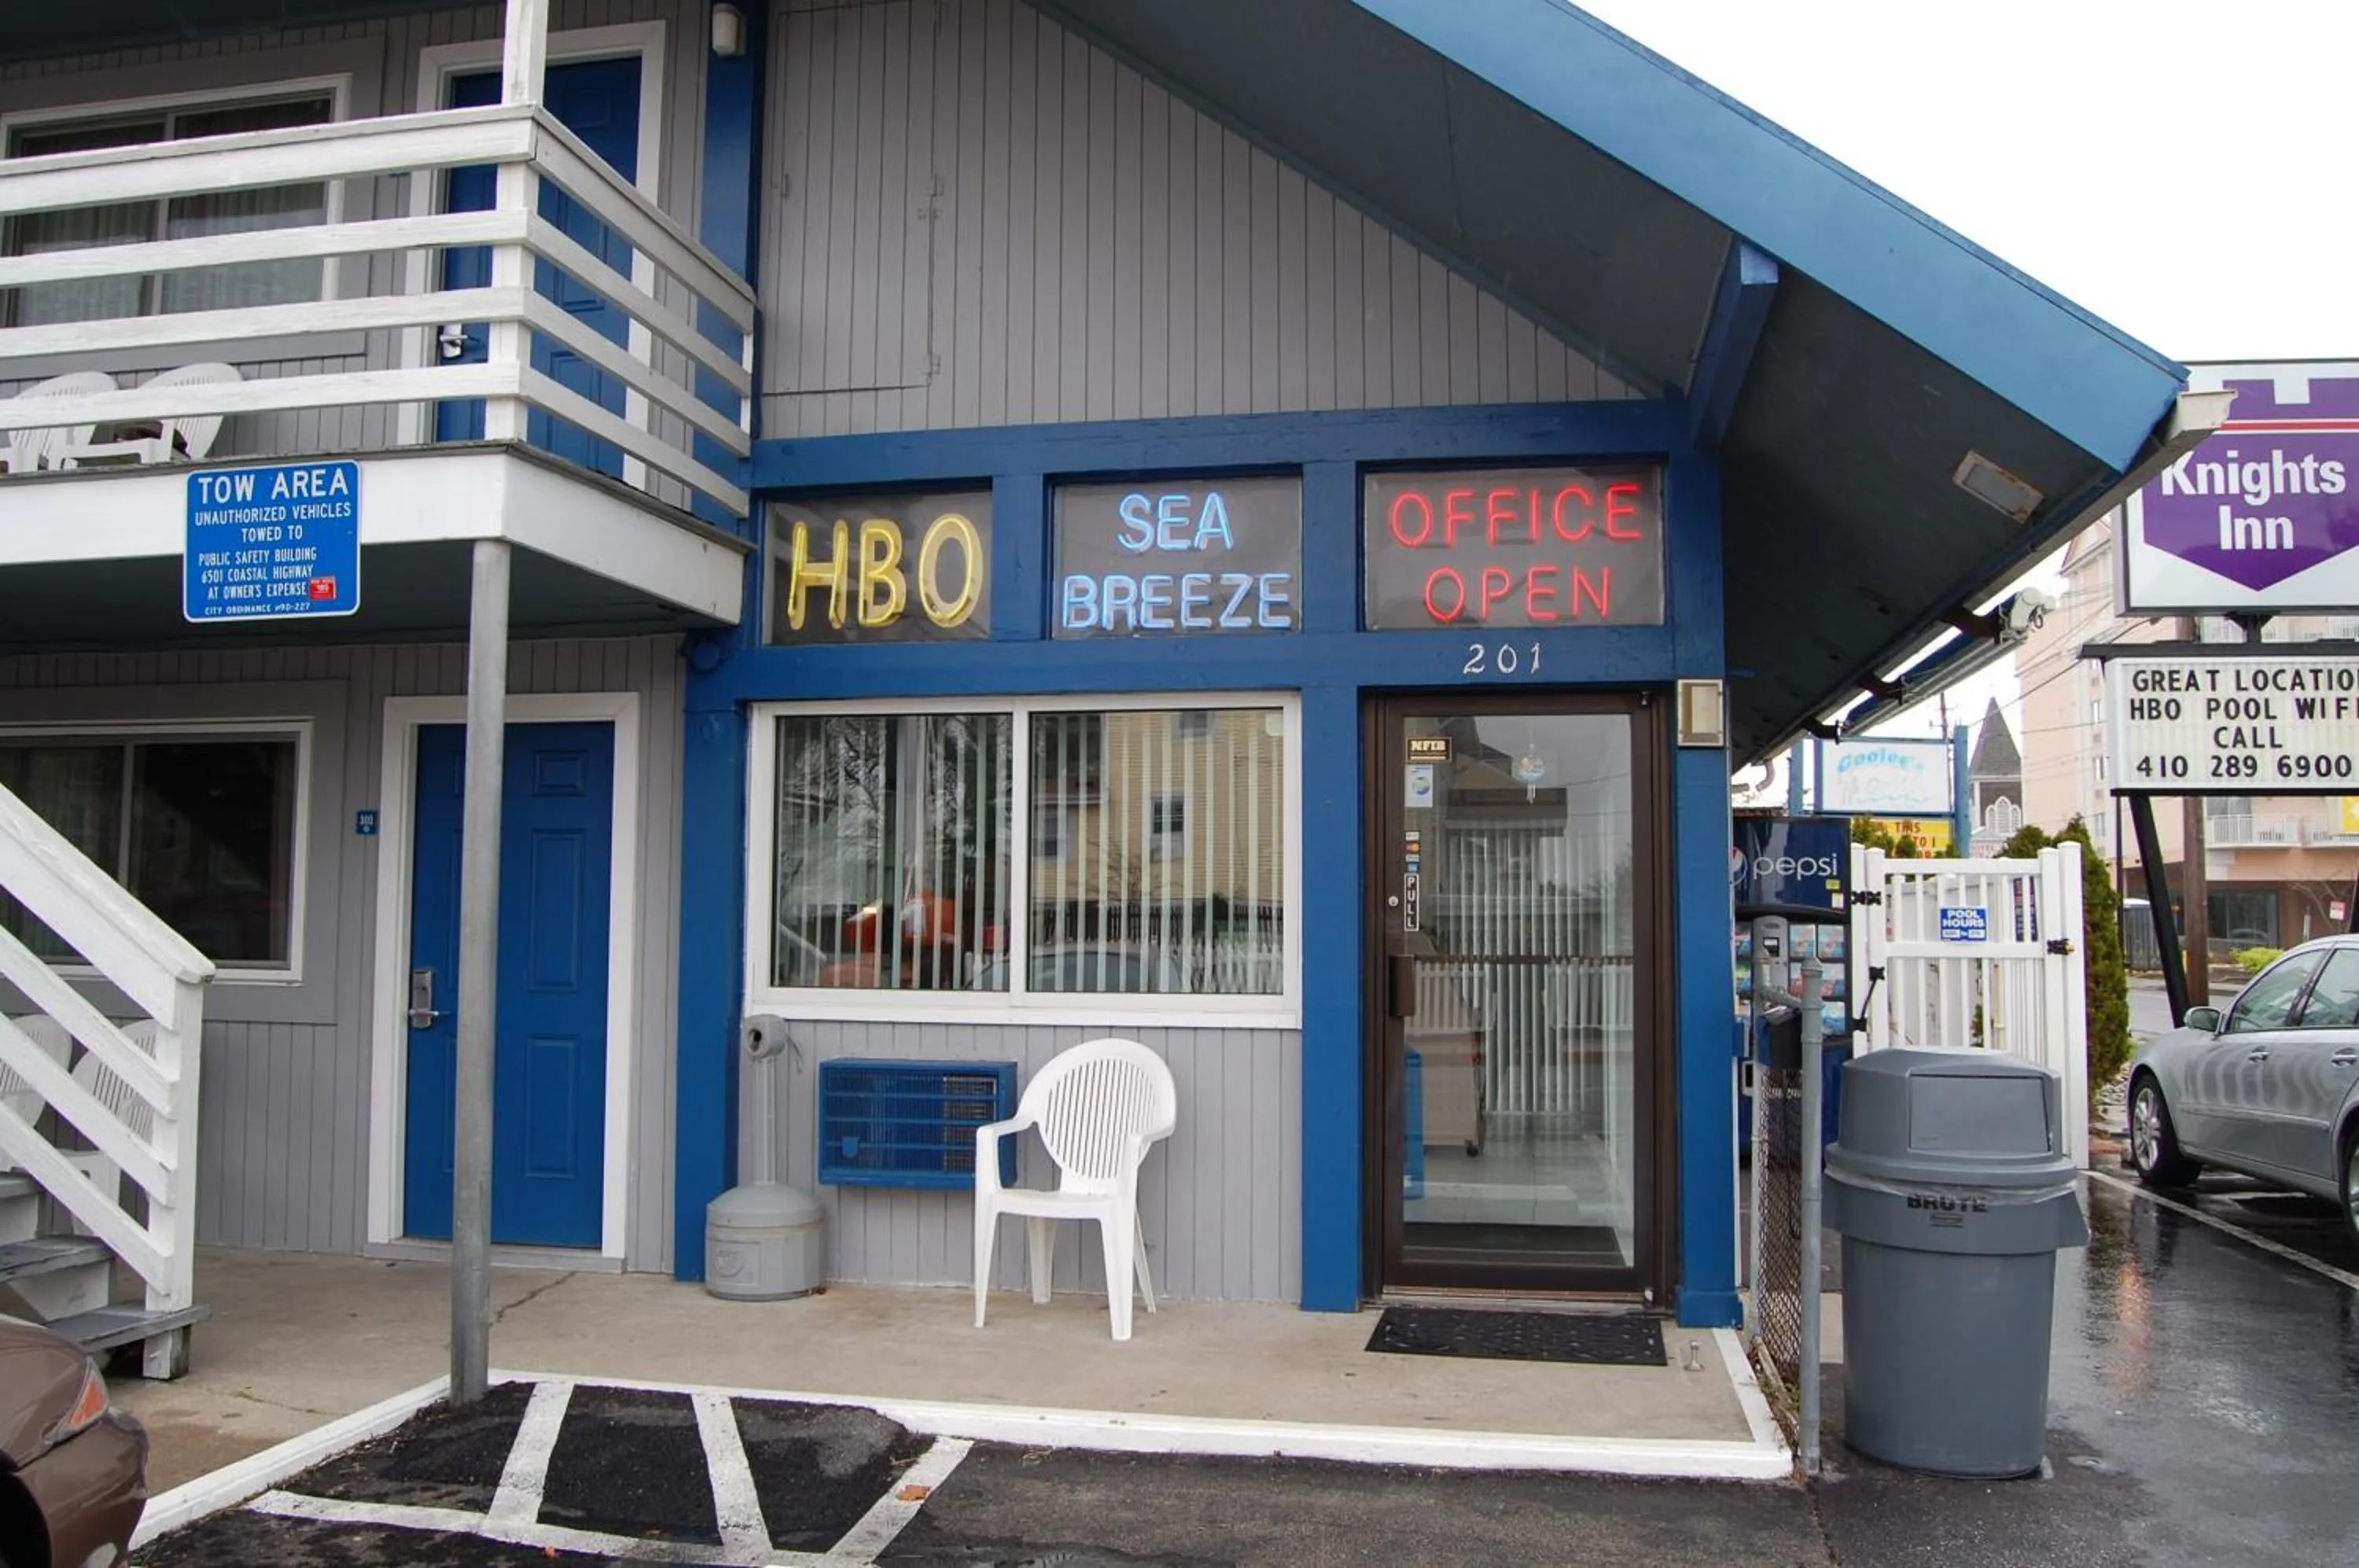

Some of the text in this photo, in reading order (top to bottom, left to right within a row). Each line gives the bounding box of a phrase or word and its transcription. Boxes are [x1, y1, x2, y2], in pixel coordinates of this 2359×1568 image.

[197, 467, 349, 504] TOW AREA
[2162, 449, 2346, 506] Knights
[195, 502, 351, 526] UNAUTHORIZED VEHICLES
[1117, 491, 1233, 551] SEA
[1390, 483, 1643, 548] OFFICE
[241, 525, 303, 543] TOWED TO
[2218, 505, 2295, 550] Inn
[199, 547, 317, 567] PUBLIC SAFETY BUILDING
[201, 564, 313, 583] 6501 COASTAL HIGHWAY
[787, 513, 984, 630] HBO
[208, 586, 219, 600] AT
[223, 584, 262, 600] OWNER'S
[267, 582, 307, 598] EXPENSE
[1062, 573, 1294, 630] BREEZE
[1424, 565, 1611, 624] OPEN
[205, 606, 223, 616] CITY
[226, 603, 271, 614] ORDINANCE
[1463, 642, 1542, 674] 201
[2132, 668, 2359, 692] GREAT LOCATIO
[2130, 698, 2181, 721] HBO
[2206, 698, 2277, 720] POOL
[2214, 726, 2283, 749] CALL
[2136, 754, 2352, 778] 410 289 6900
[1753, 852, 1838, 881] pepsi
[1407, 877, 1415, 927] PULL
[1948, 910, 1981, 918] POOL
[1943, 918, 1984, 927] HOURS
